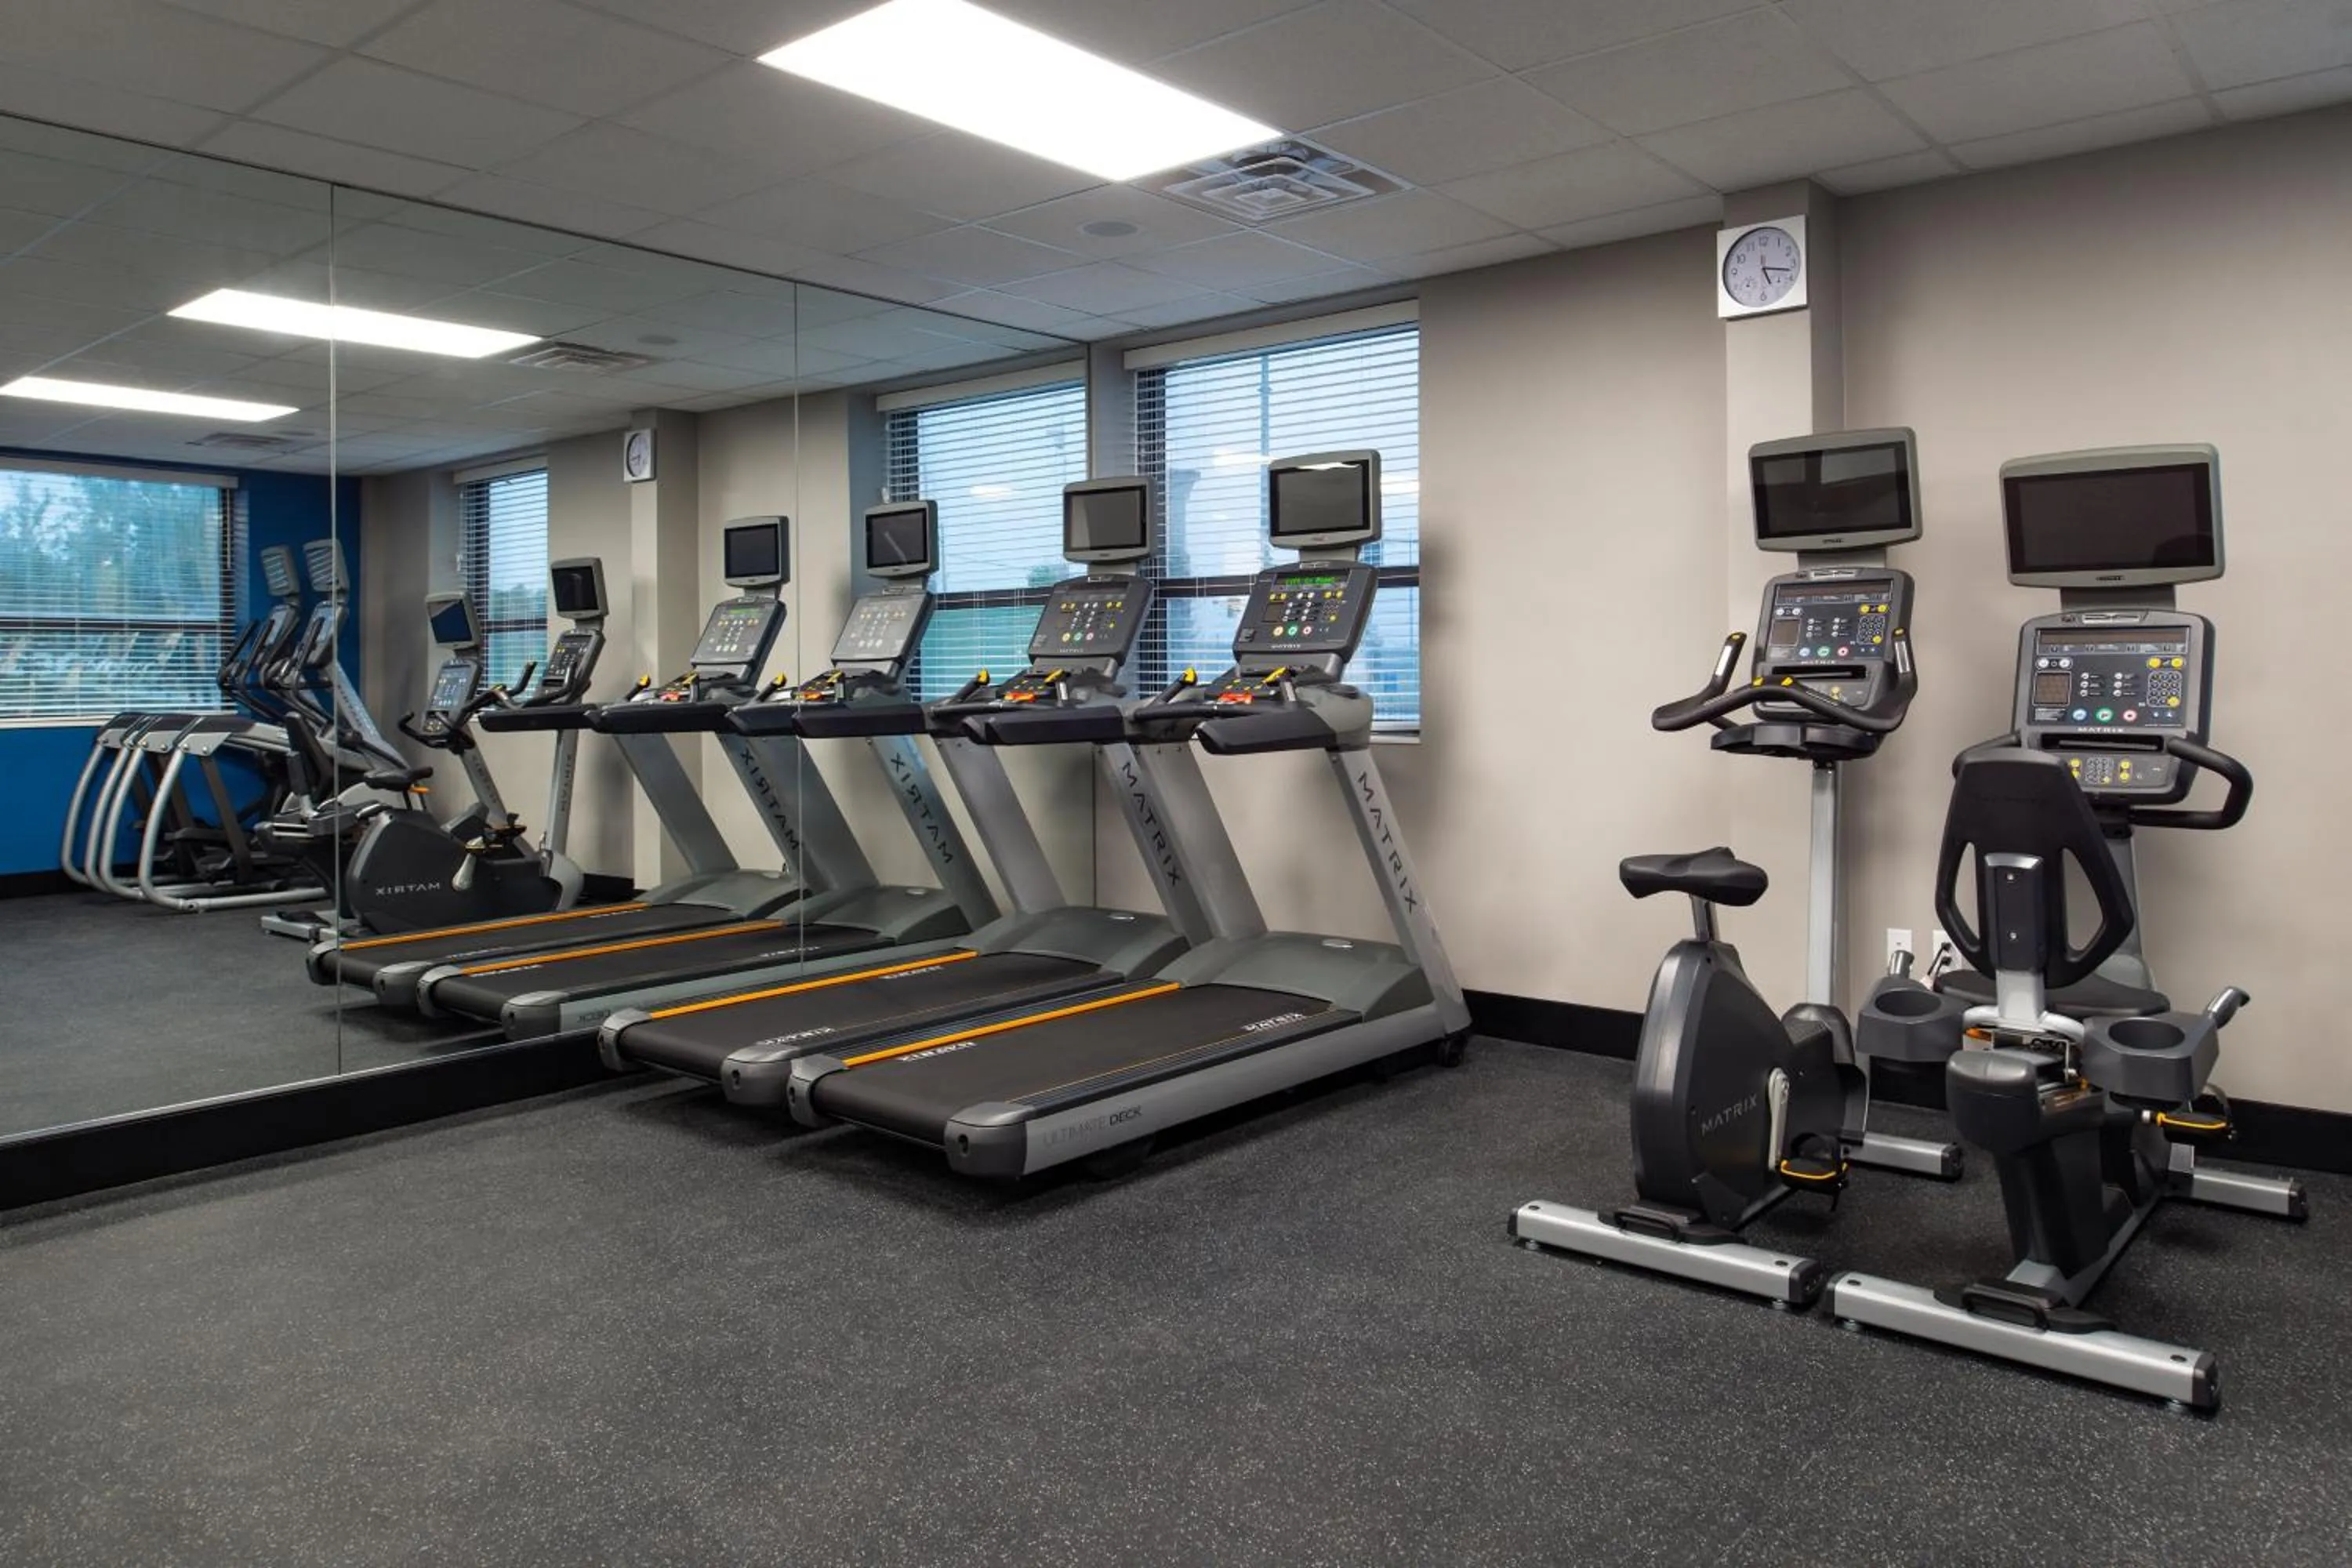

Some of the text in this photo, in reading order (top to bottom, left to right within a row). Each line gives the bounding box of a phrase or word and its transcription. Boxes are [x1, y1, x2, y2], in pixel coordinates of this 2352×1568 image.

[1759, 236, 1769, 246] 12
[1737, 253, 1746, 263] 10
[1122, 761, 1181, 887] MATRIX
[1357, 771, 1417, 913] MATRIX
[1109, 1104, 1142, 1127] DECK
[1700, 1093, 1757, 1137] MATRIX
